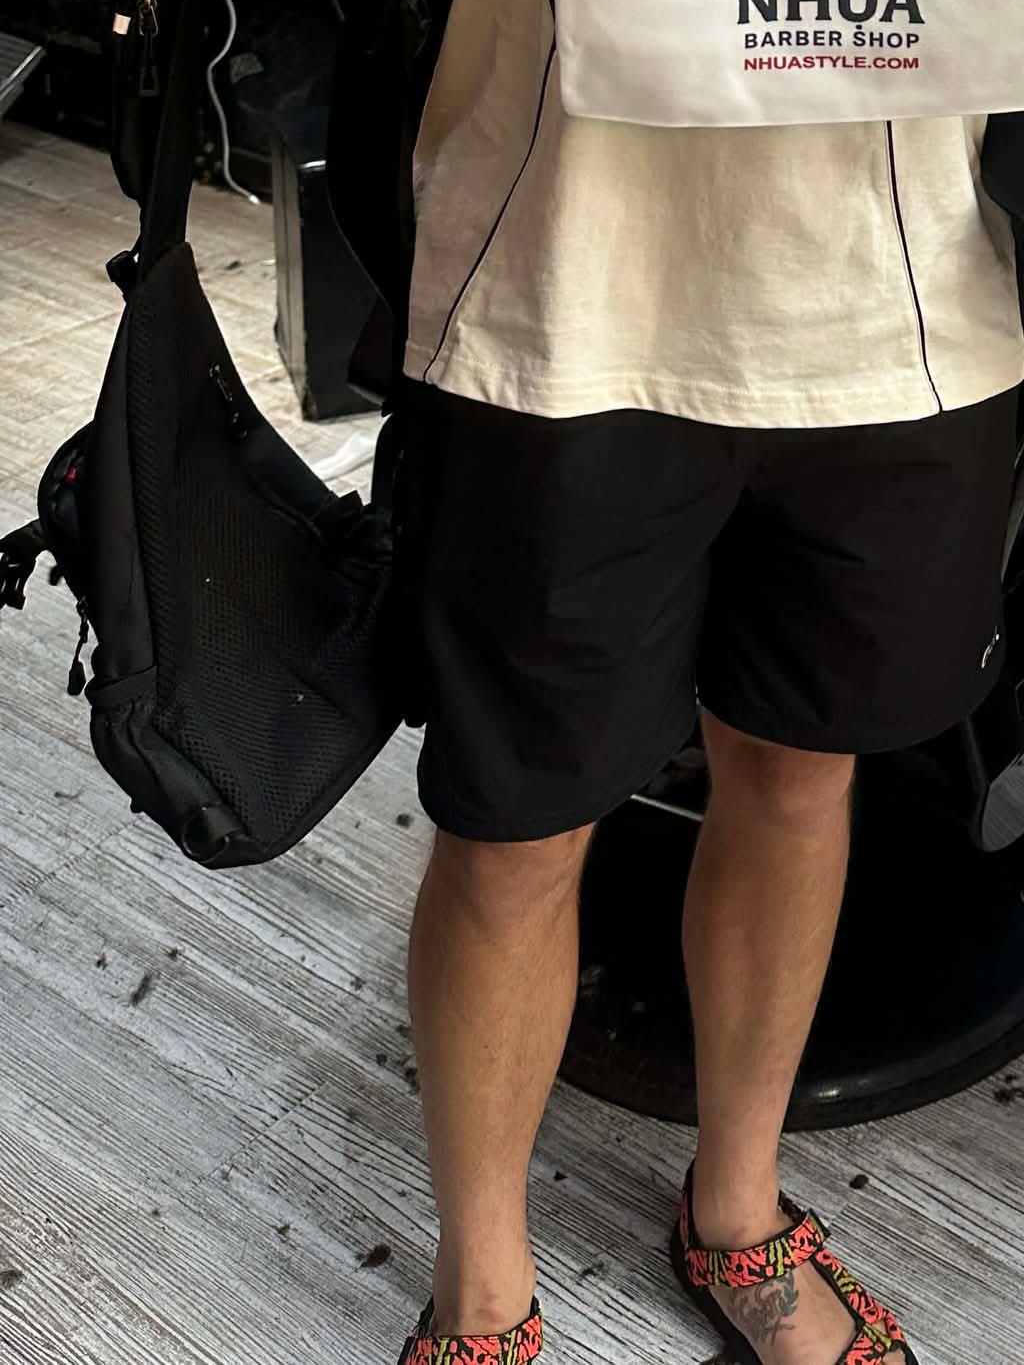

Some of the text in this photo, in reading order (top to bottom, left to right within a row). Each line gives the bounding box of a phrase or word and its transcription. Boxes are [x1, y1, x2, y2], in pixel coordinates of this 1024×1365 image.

[744, 31, 920, 49] BARBER SHOP
[744, 56, 919, 70] NHUASTYLE.COM
